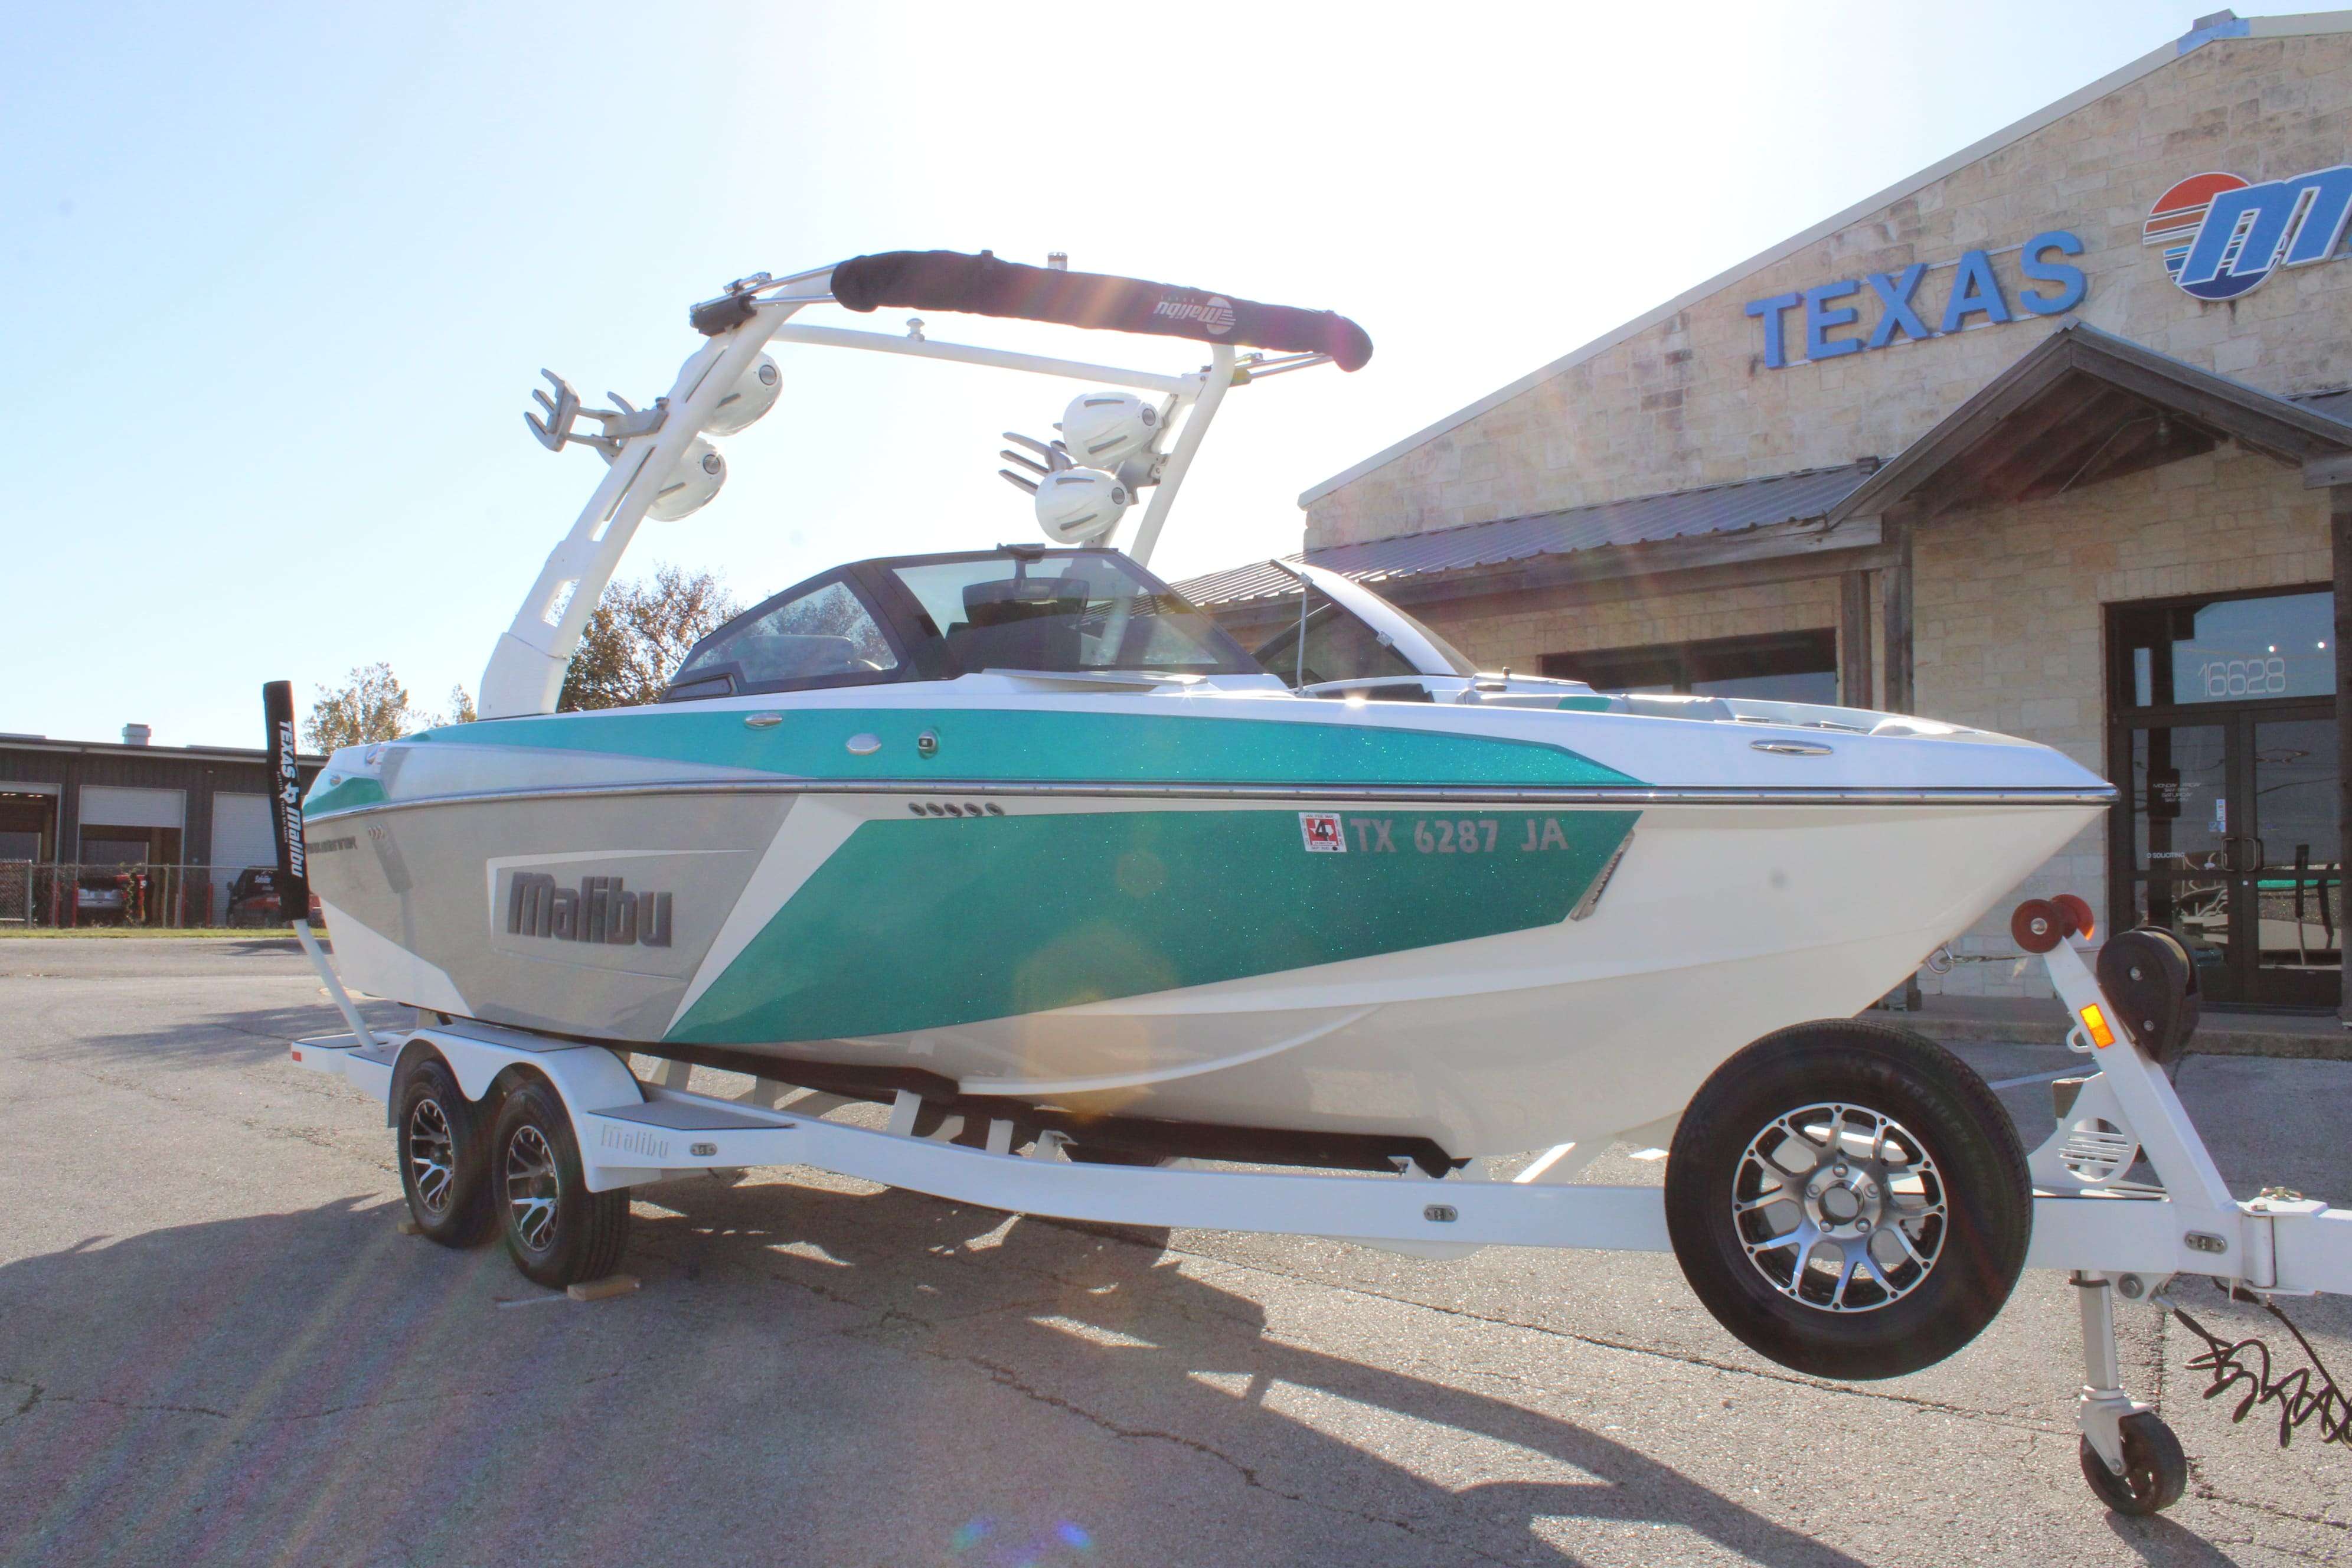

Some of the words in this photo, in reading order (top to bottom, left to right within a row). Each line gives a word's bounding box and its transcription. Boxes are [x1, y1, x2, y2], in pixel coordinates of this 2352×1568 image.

[1153, 301, 1226, 325] Malibu
[1745, 230, 2088, 370] TEXAS
[2198, 657, 2286, 697] 16628
[279, 721, 296, 779] TEXAS
[286, 805, 304, 878] Malibu
[1315, 819, 1329, 841] 4
[1350, 818, 1397, 853] TX
[1414, 819, 1498, 853] 6287
[1520, 818, 1569, 852] JA
[507, 871, 672, 948] Malibu
[600, 1123, 669, 1159] Malibu
